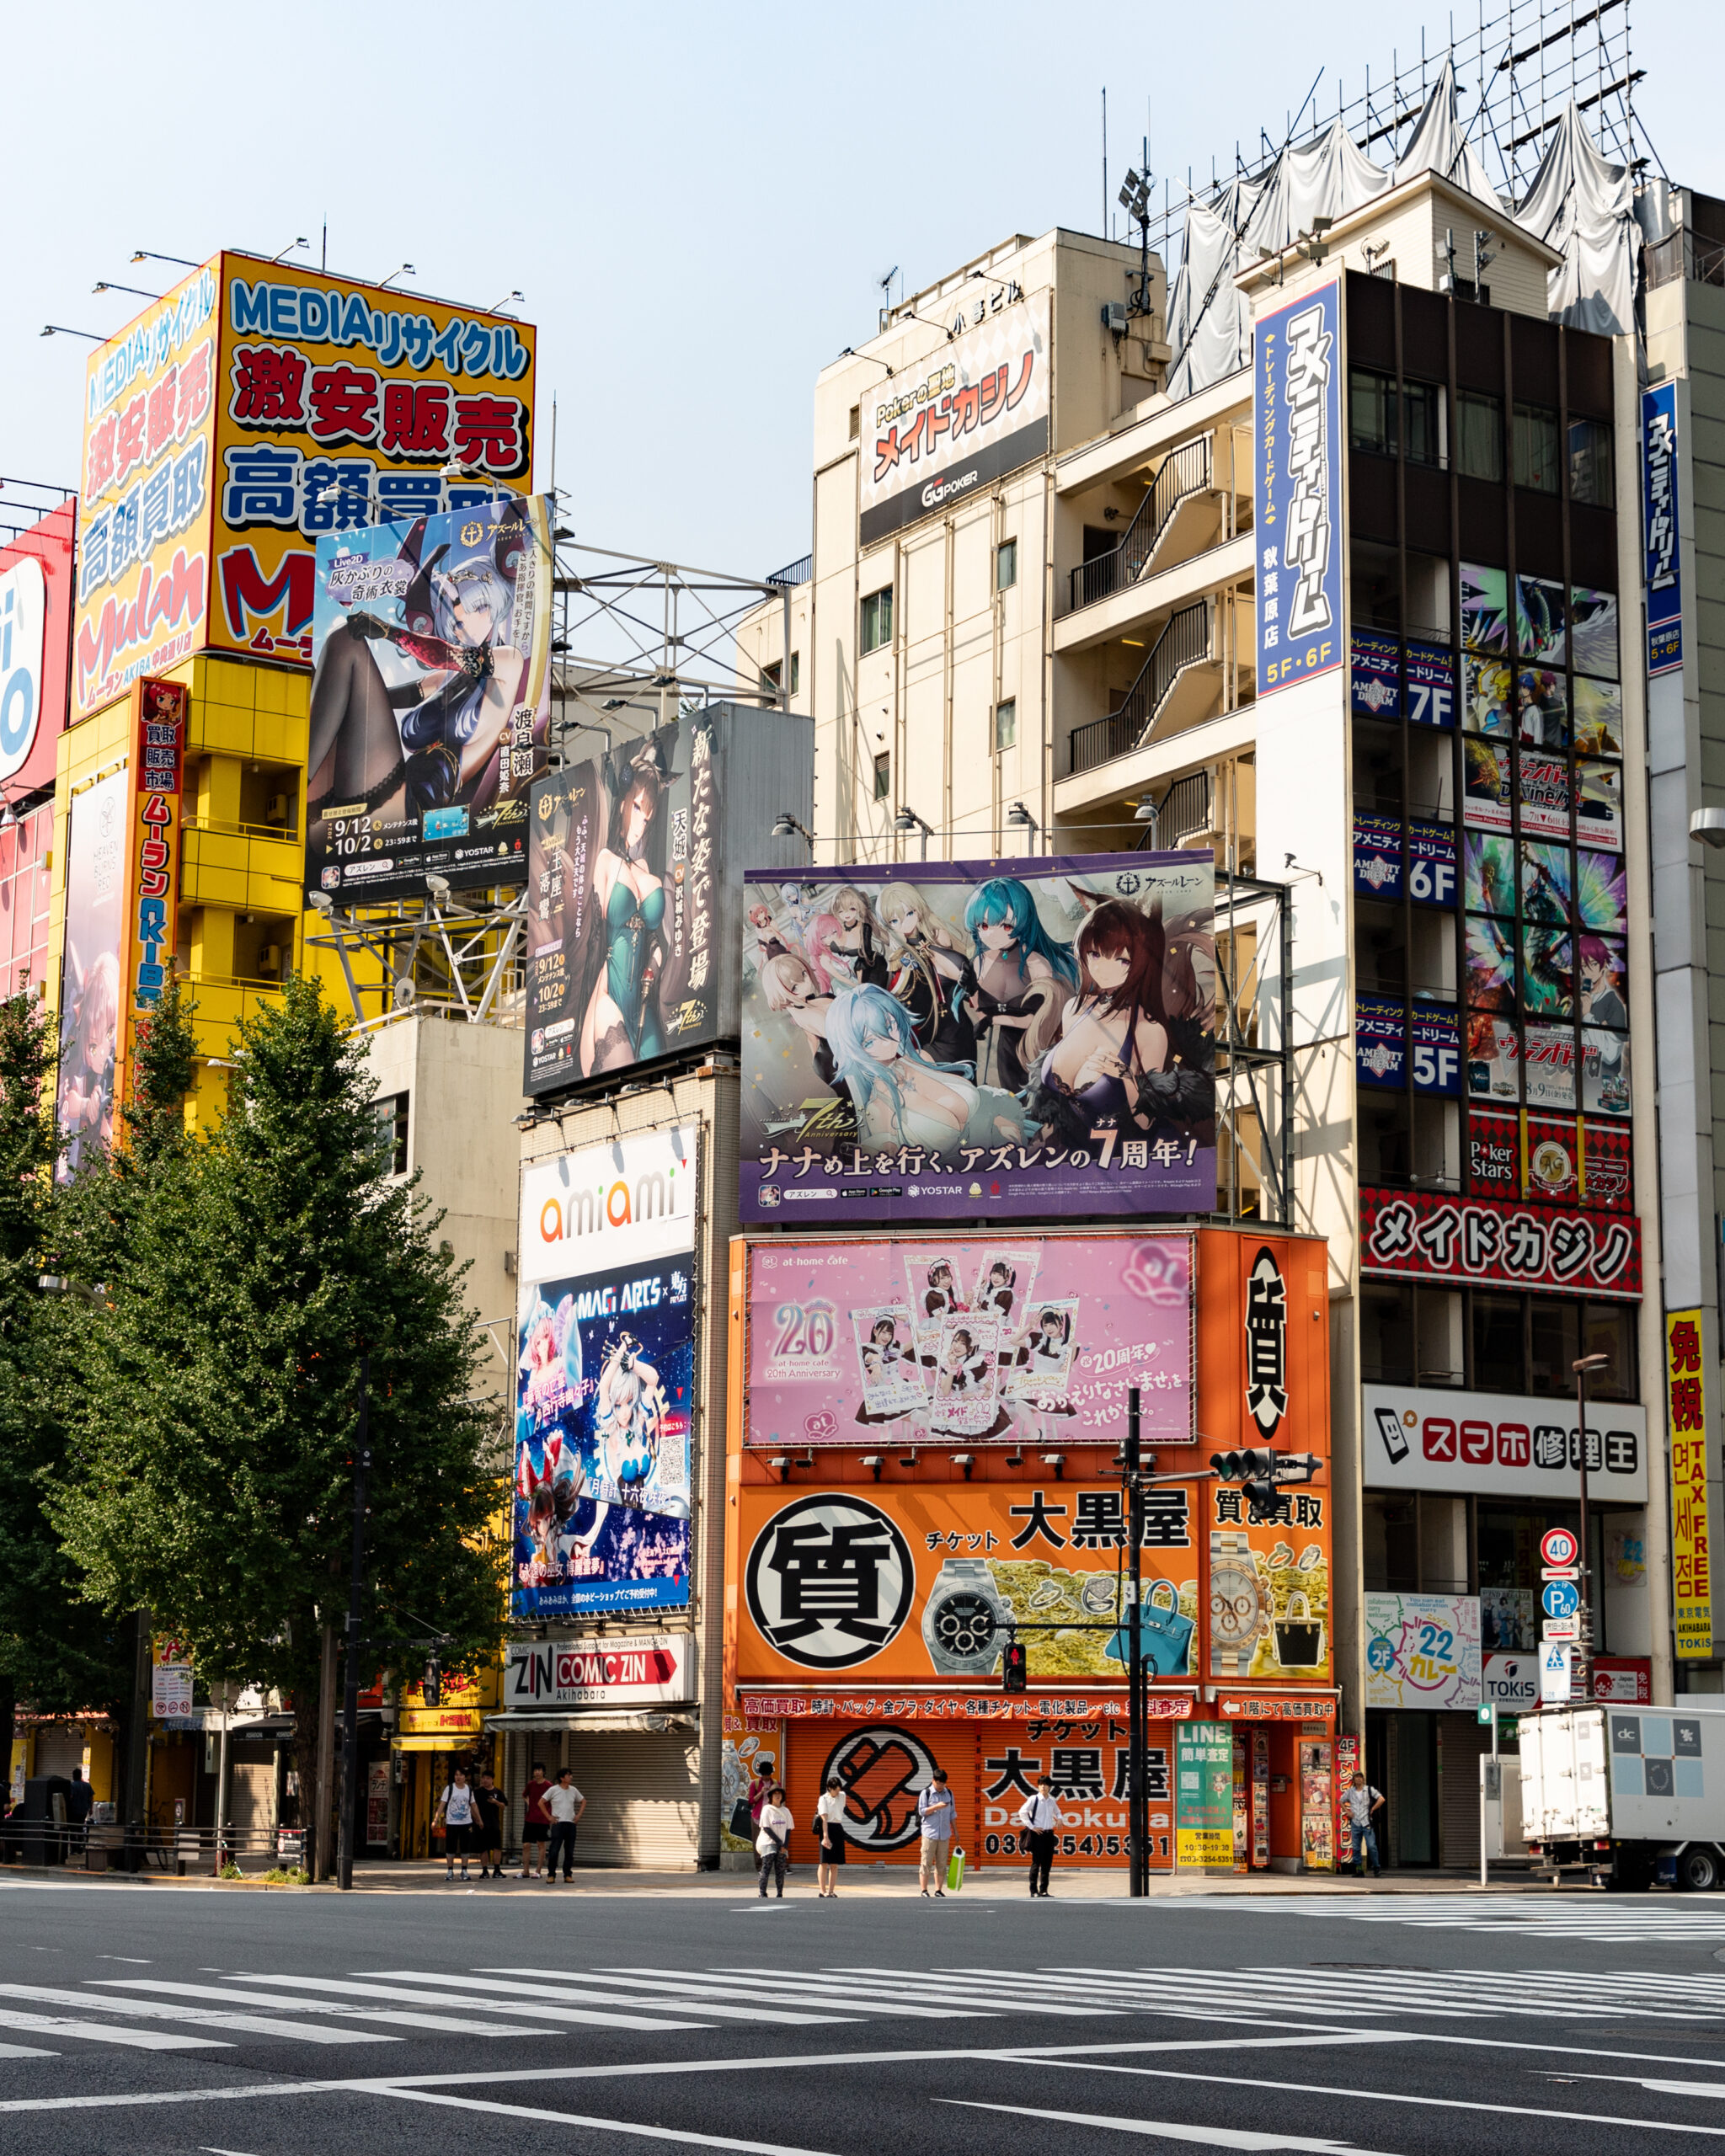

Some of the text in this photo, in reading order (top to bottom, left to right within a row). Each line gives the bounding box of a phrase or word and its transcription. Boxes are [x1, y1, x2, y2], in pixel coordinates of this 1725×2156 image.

[230, 278, 529, 379] MEDIAリサイクル
[88, 267, 216, 424] MEDIAリサイクル
[876, 363, 956, 429] Pokerの聖地
[230, 343, 524, 472] 激安販売
[873, 349, 1034, 483] メイドカジノ
[87, 338, 212, 503] 激安販売
[78, 433, 205, 607] 高額買取
[486, 518, 540, 542] アズールレーン
[334, 554, 363, 568] Live2D
[330, 564, 393, 587] 灰かぶりの
[1263, 546, 1279, 649] 秋葉原店
[77, 547, 206, 710] Mulan
[1651, 630, 1680, 647] 秋葉原店
[1352, 680, 1398, 697] AMENITY
[1357, 691, 1394, 707] DREAM
[1407, 683, 1452, 724] 7F
[147, 725, 176, 744] 買取
[499, 732, 510, 742] CV
[146, 749, 175, 768] 販売
[145, 771, 174, 790] 市場
[334, 816, 371, 837] 9/12
[139, 794, 170, 897] ムーラン
[334, 835, 371, 856] 10/2
[464, 846, 494, 857] YOSTAR
[687, 723, 713, 992] 新たな姿で登場
[1354, 858, 1401, 874] AMENITY
[349, 864, 376, 873] アズレン
[1359, 869, 1396, 883] DREAM
[1145, 875, 1204, 891] アズールレーン
[1409, 861, 1455, 901] 6F
[539, 953, 559, 974] 9/12
[538, 982, 559, 1003] 10/2
[1356, 1047, 1403, 1062] AMENITY
[1361, 1057, 1399, 1071] DREAM
[1413, 1045, 1459, 1086] 5F
[804, 1130, 858, 1139] Anniversary
[1471, 1159, 1513, 1180] Stars
[788, 1190, 817, 1198] アズレン
[921, 1186, 963, 1195] YOSTAR
[540, 1167, 676, 1243] amiami
[1370, 1200, 1632, 1284] メイドカジノ
[620, 1277, 661, 1311] ARTS
[766, 1369, 841, 1380] 20th Anniversary
[1669, 1320, 1703, 1433] 免税
[1425, 1422, 1637, 1470] スマホ修理王
[926, 1488, 1191, 1552] チケット 大黒屋
[1690, 1440, 1709, 1598] TAX FREE
[1550, 1540, 1569, 1556] 40
[1551, 1590, 1571, 1614] P 60
[1677, 1605, 1711, 1621] 東京電気
[1678, 1622, 1712, 1635] AKIHABARA
[511, 1646, 530, 1656] COMIC
[557, 1641, 583, 1652] Professional
[610, 1639, 633, 1649] Magazine
[1419, 1625, 1454, 1662] 22
[558, 1653, 646, 1684] COMIC ZIN
[1372, 1650, 1391, 1668] 2F
[1409, 1654, 1457, 1681] カレー
[511, 1644, 553, 1700] ZIN
[557, 1689, 606, 1701] Akihabara
[1638, 1671, 1648, 1700] 免税
[744, 1697, 806, 1715] 高価買取
[1242, 1700, 1334, 1716] 1階にて高価買取中
[1026, 1718, 1128, 1742] チケット
[1181, 1748, 1229, 1763] 簡単査定
[1340, 1739, 1355, 1753] 4F
[982, 1747, 1171, 1804] 大黒屋
